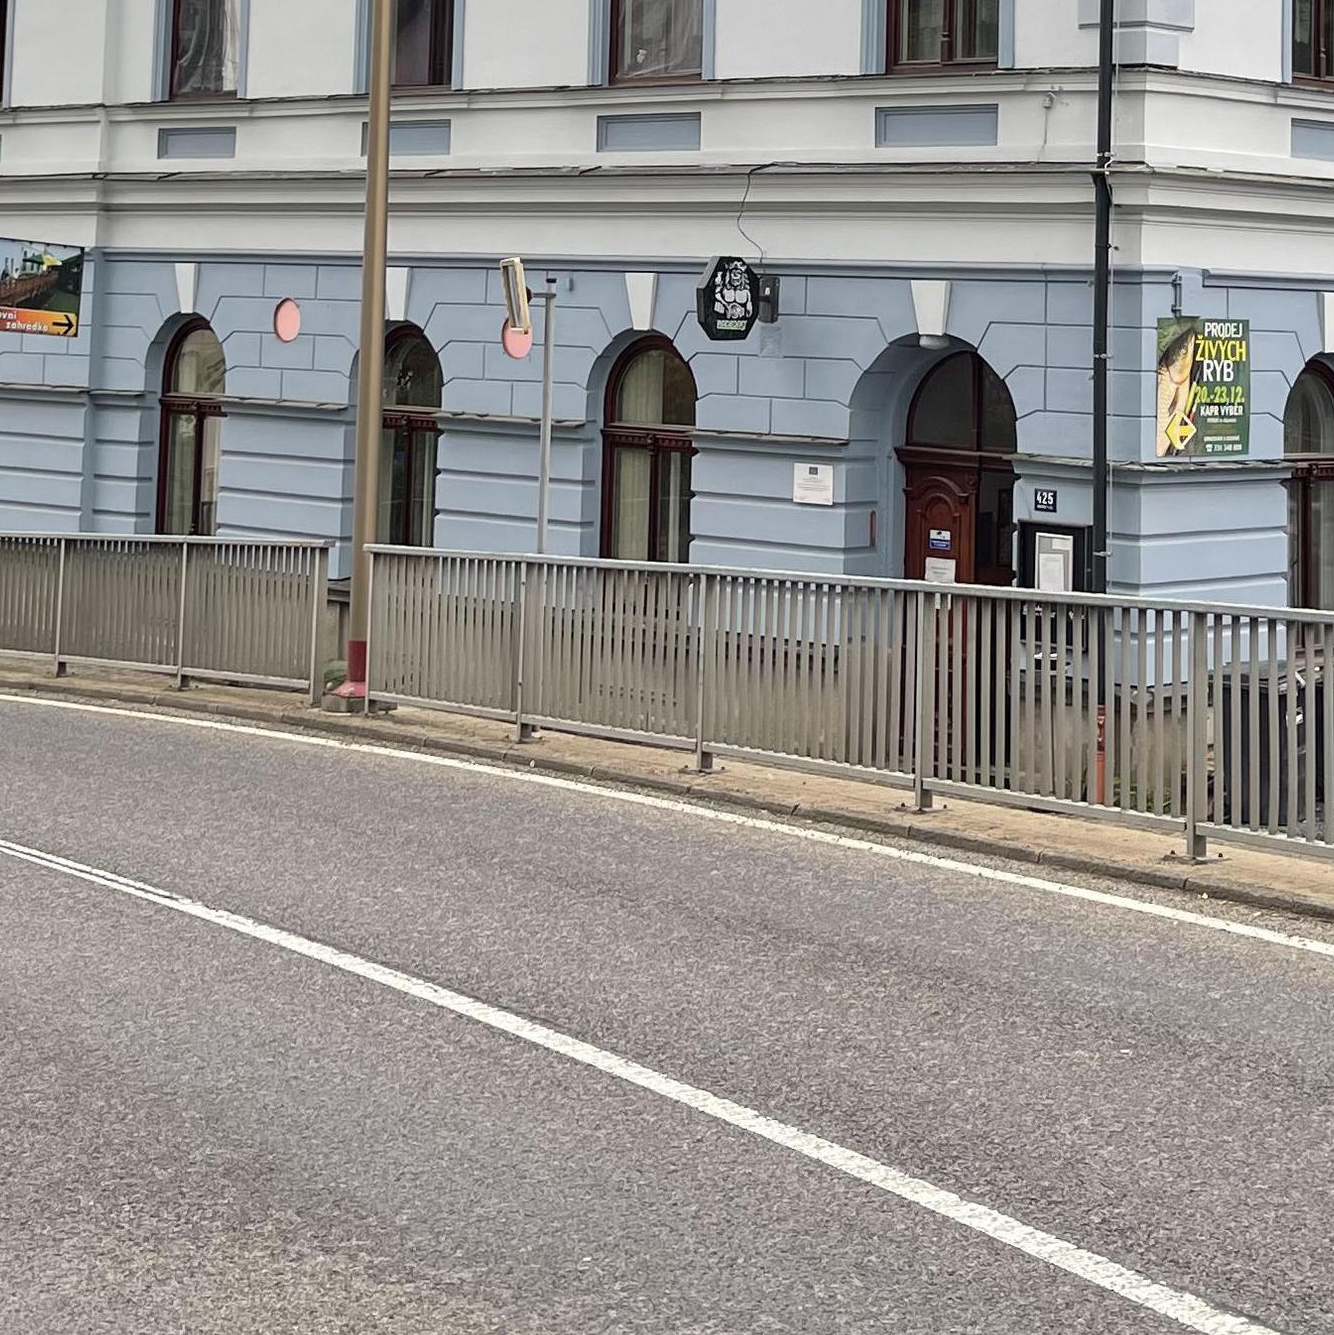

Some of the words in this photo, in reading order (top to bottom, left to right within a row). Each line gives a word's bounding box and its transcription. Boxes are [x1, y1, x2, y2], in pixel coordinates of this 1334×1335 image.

[1204, 322, 1243, 337] PRODEJ
[1195, 334, 1246, 361] ŽIVÝCH
[1203, 360, 1234, 382] RYB
[1200, 405, 1219, 416] KAPR
[1036, 491, 1054, 505] 425
